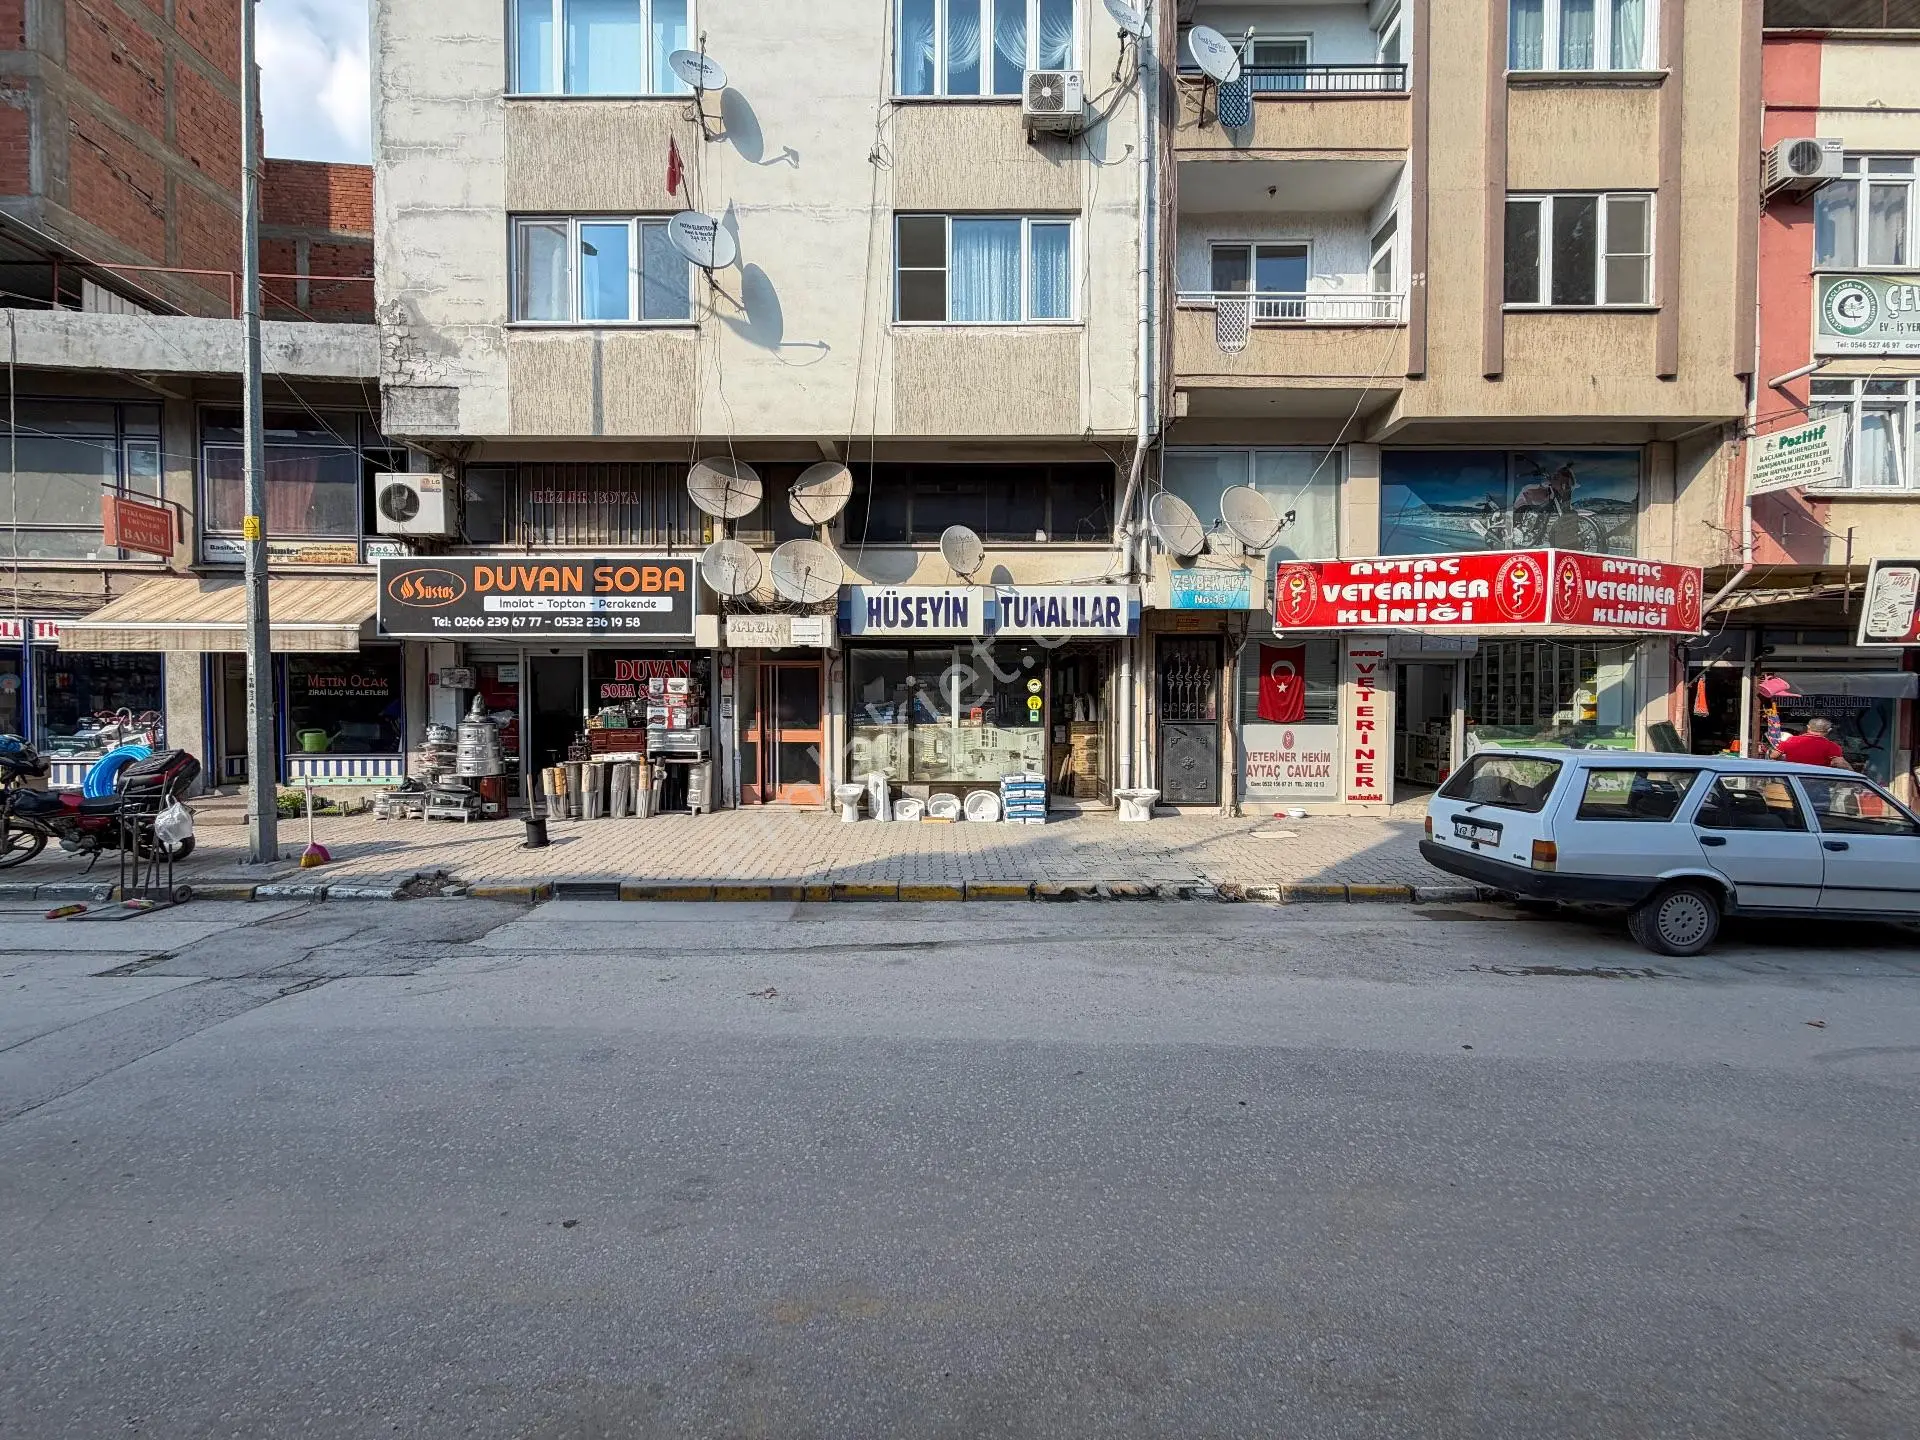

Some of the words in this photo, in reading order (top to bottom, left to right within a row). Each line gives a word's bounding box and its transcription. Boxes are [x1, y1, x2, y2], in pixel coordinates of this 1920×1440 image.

[1880, 322, 1889, 331] EV
[1779, 424, 1826, 450] Pozitif
[124, 528, 165, 547] BAYİSİ
[1350, 559, 1460, 575] AYTAÇ
[1602, 560, 1662, 581] AYTAÇ
[474, 566, 583, 592] DUVAN
[594, 566, 685, 592] SOBA
[1174, 575, 1219, 591] ZEYBEK
[1322, 574, 1489, 602] VETERİNER
[1585, 577, 1675, 605] VETERİNER
[547, 598, 586, 611] Toptan
[599, 598, 657, 609] Perakende
[867, 591, 969, 628] HÜSEYİN
[1001, 596, 1122, 628] TUNALILAR
[1337, 602, 1473, 623] KLİNİĞİ
[1593, 604, 1667, 626] KLİNİĞİ
[432, 616, 451, 627] Tel:
[454, 617, 484, 627] 0266
[487, 617, 509, 627] 239
[512, 617, 527, 627] 67
[528, 617, 542, 627] 77
[554, 616, 584, 627] 0532
[586, 616, 608, 627] 236
[610, 616, 622, 627] 19
[624, 616, 641, 627] 58
[615, 660, 691, 681] DUVAN
[601, 684, 636, 698] SOBA
[1355, 664, 1376, 787] VETERİNER
[1247, 750, 1296, 762] VETERİNER
[1302, 750, 1331, 762] HEKİM
[1246, 765, 1281, 780] AYTAÇ
[1287, 765, 1331, 778] CAVLAK
